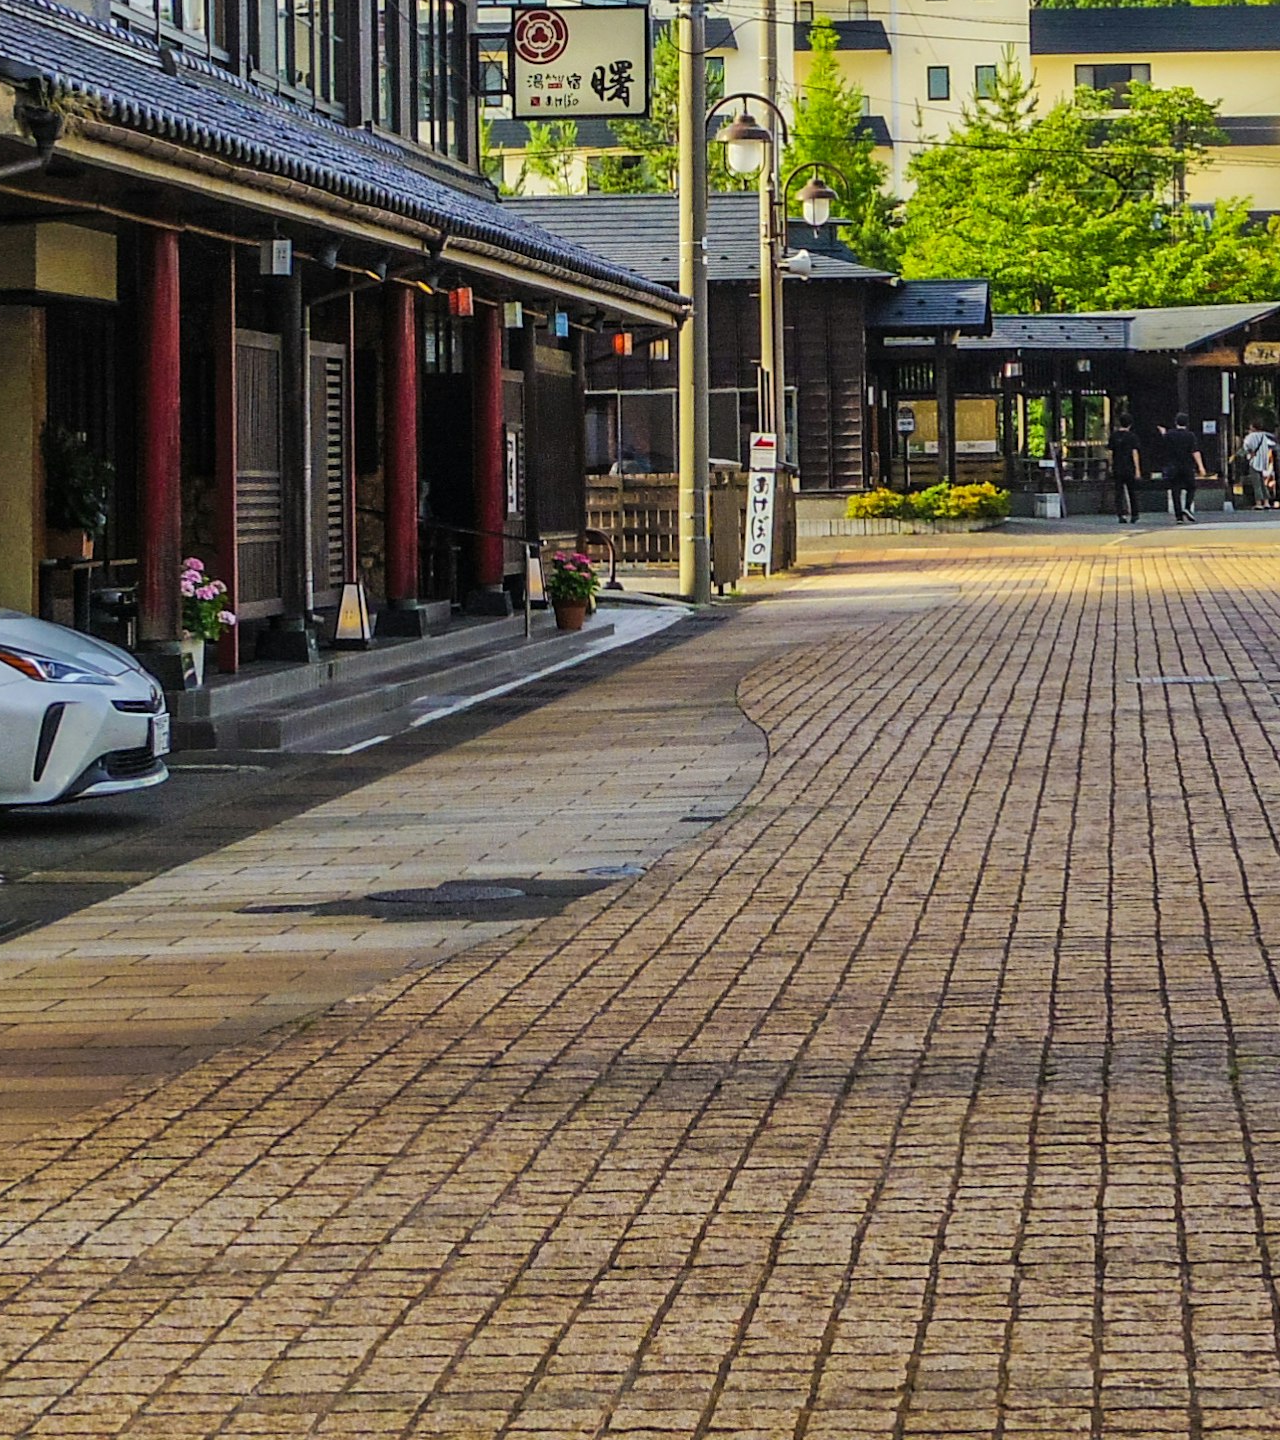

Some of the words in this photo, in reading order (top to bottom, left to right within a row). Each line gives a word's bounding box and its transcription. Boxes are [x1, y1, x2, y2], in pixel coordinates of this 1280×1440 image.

[590, 60, 635, 108] 曙
[751, 476, 769, 555] あけぼの
